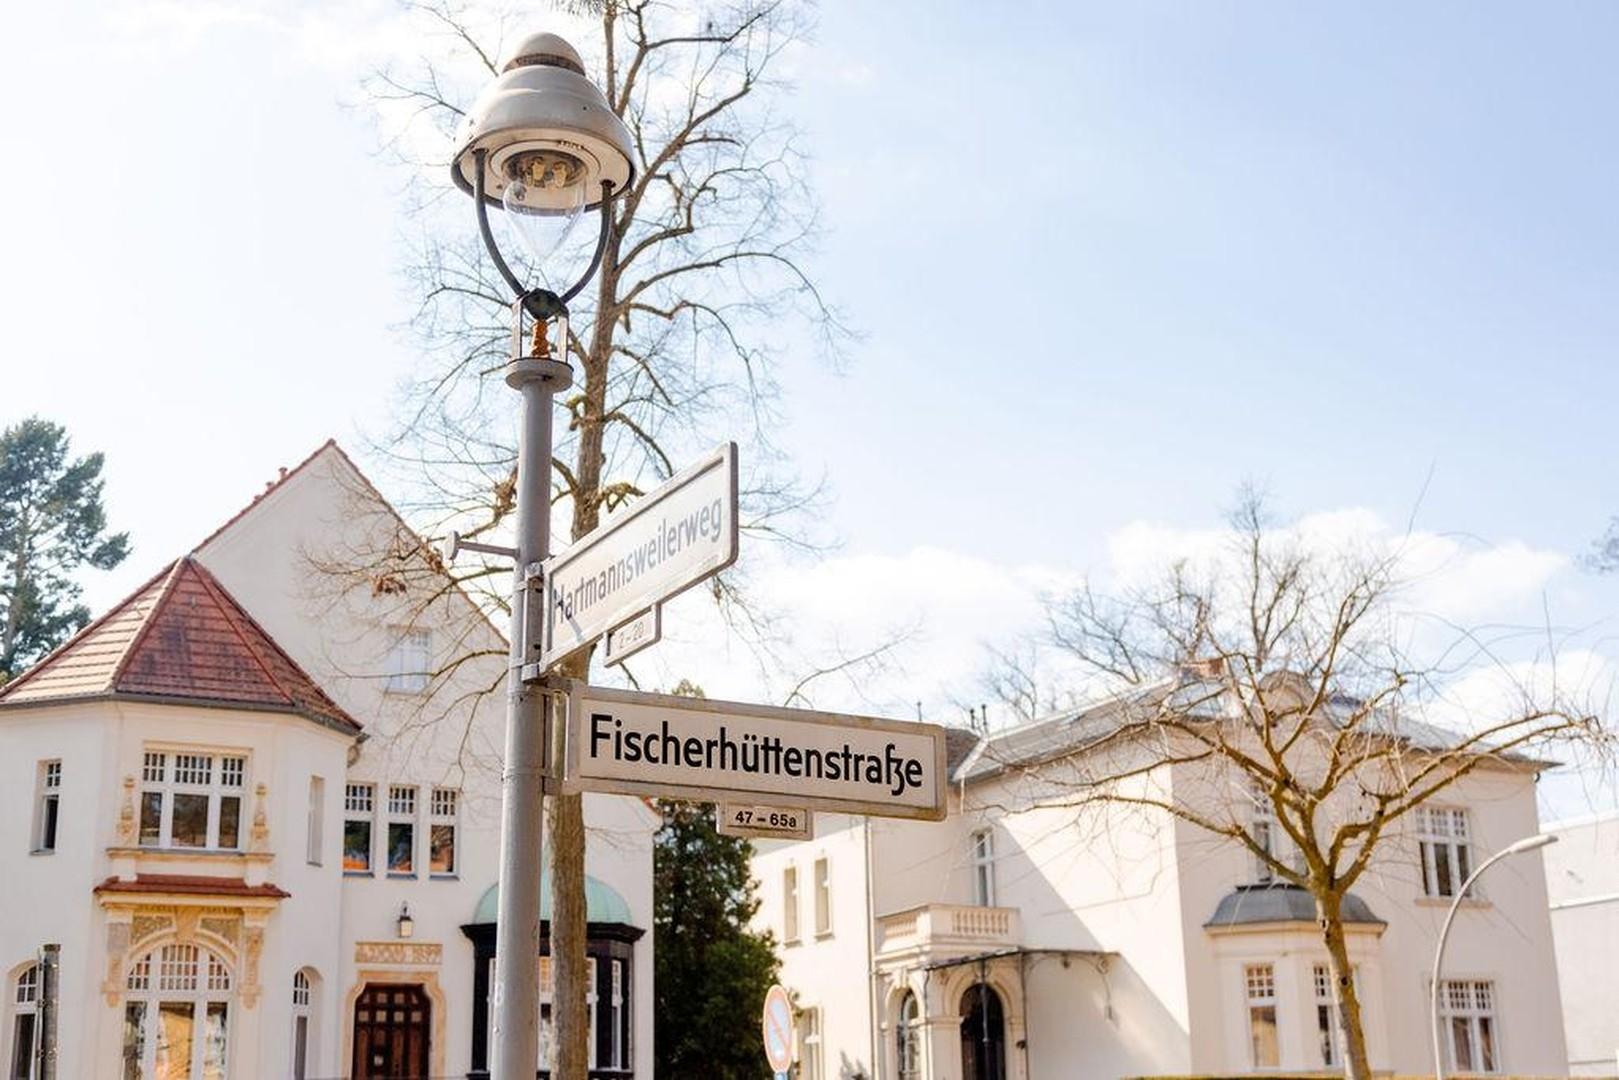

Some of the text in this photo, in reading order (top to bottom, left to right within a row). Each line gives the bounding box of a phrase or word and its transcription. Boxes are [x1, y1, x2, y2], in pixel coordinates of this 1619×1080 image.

[552, 497, 722, 628] Hartmannsweilerweg
[590, 713, 923, 796] Fischerhüttenstraße
[735, 810, 753, 824] 47
[770, 812, 797, 828] 65a
